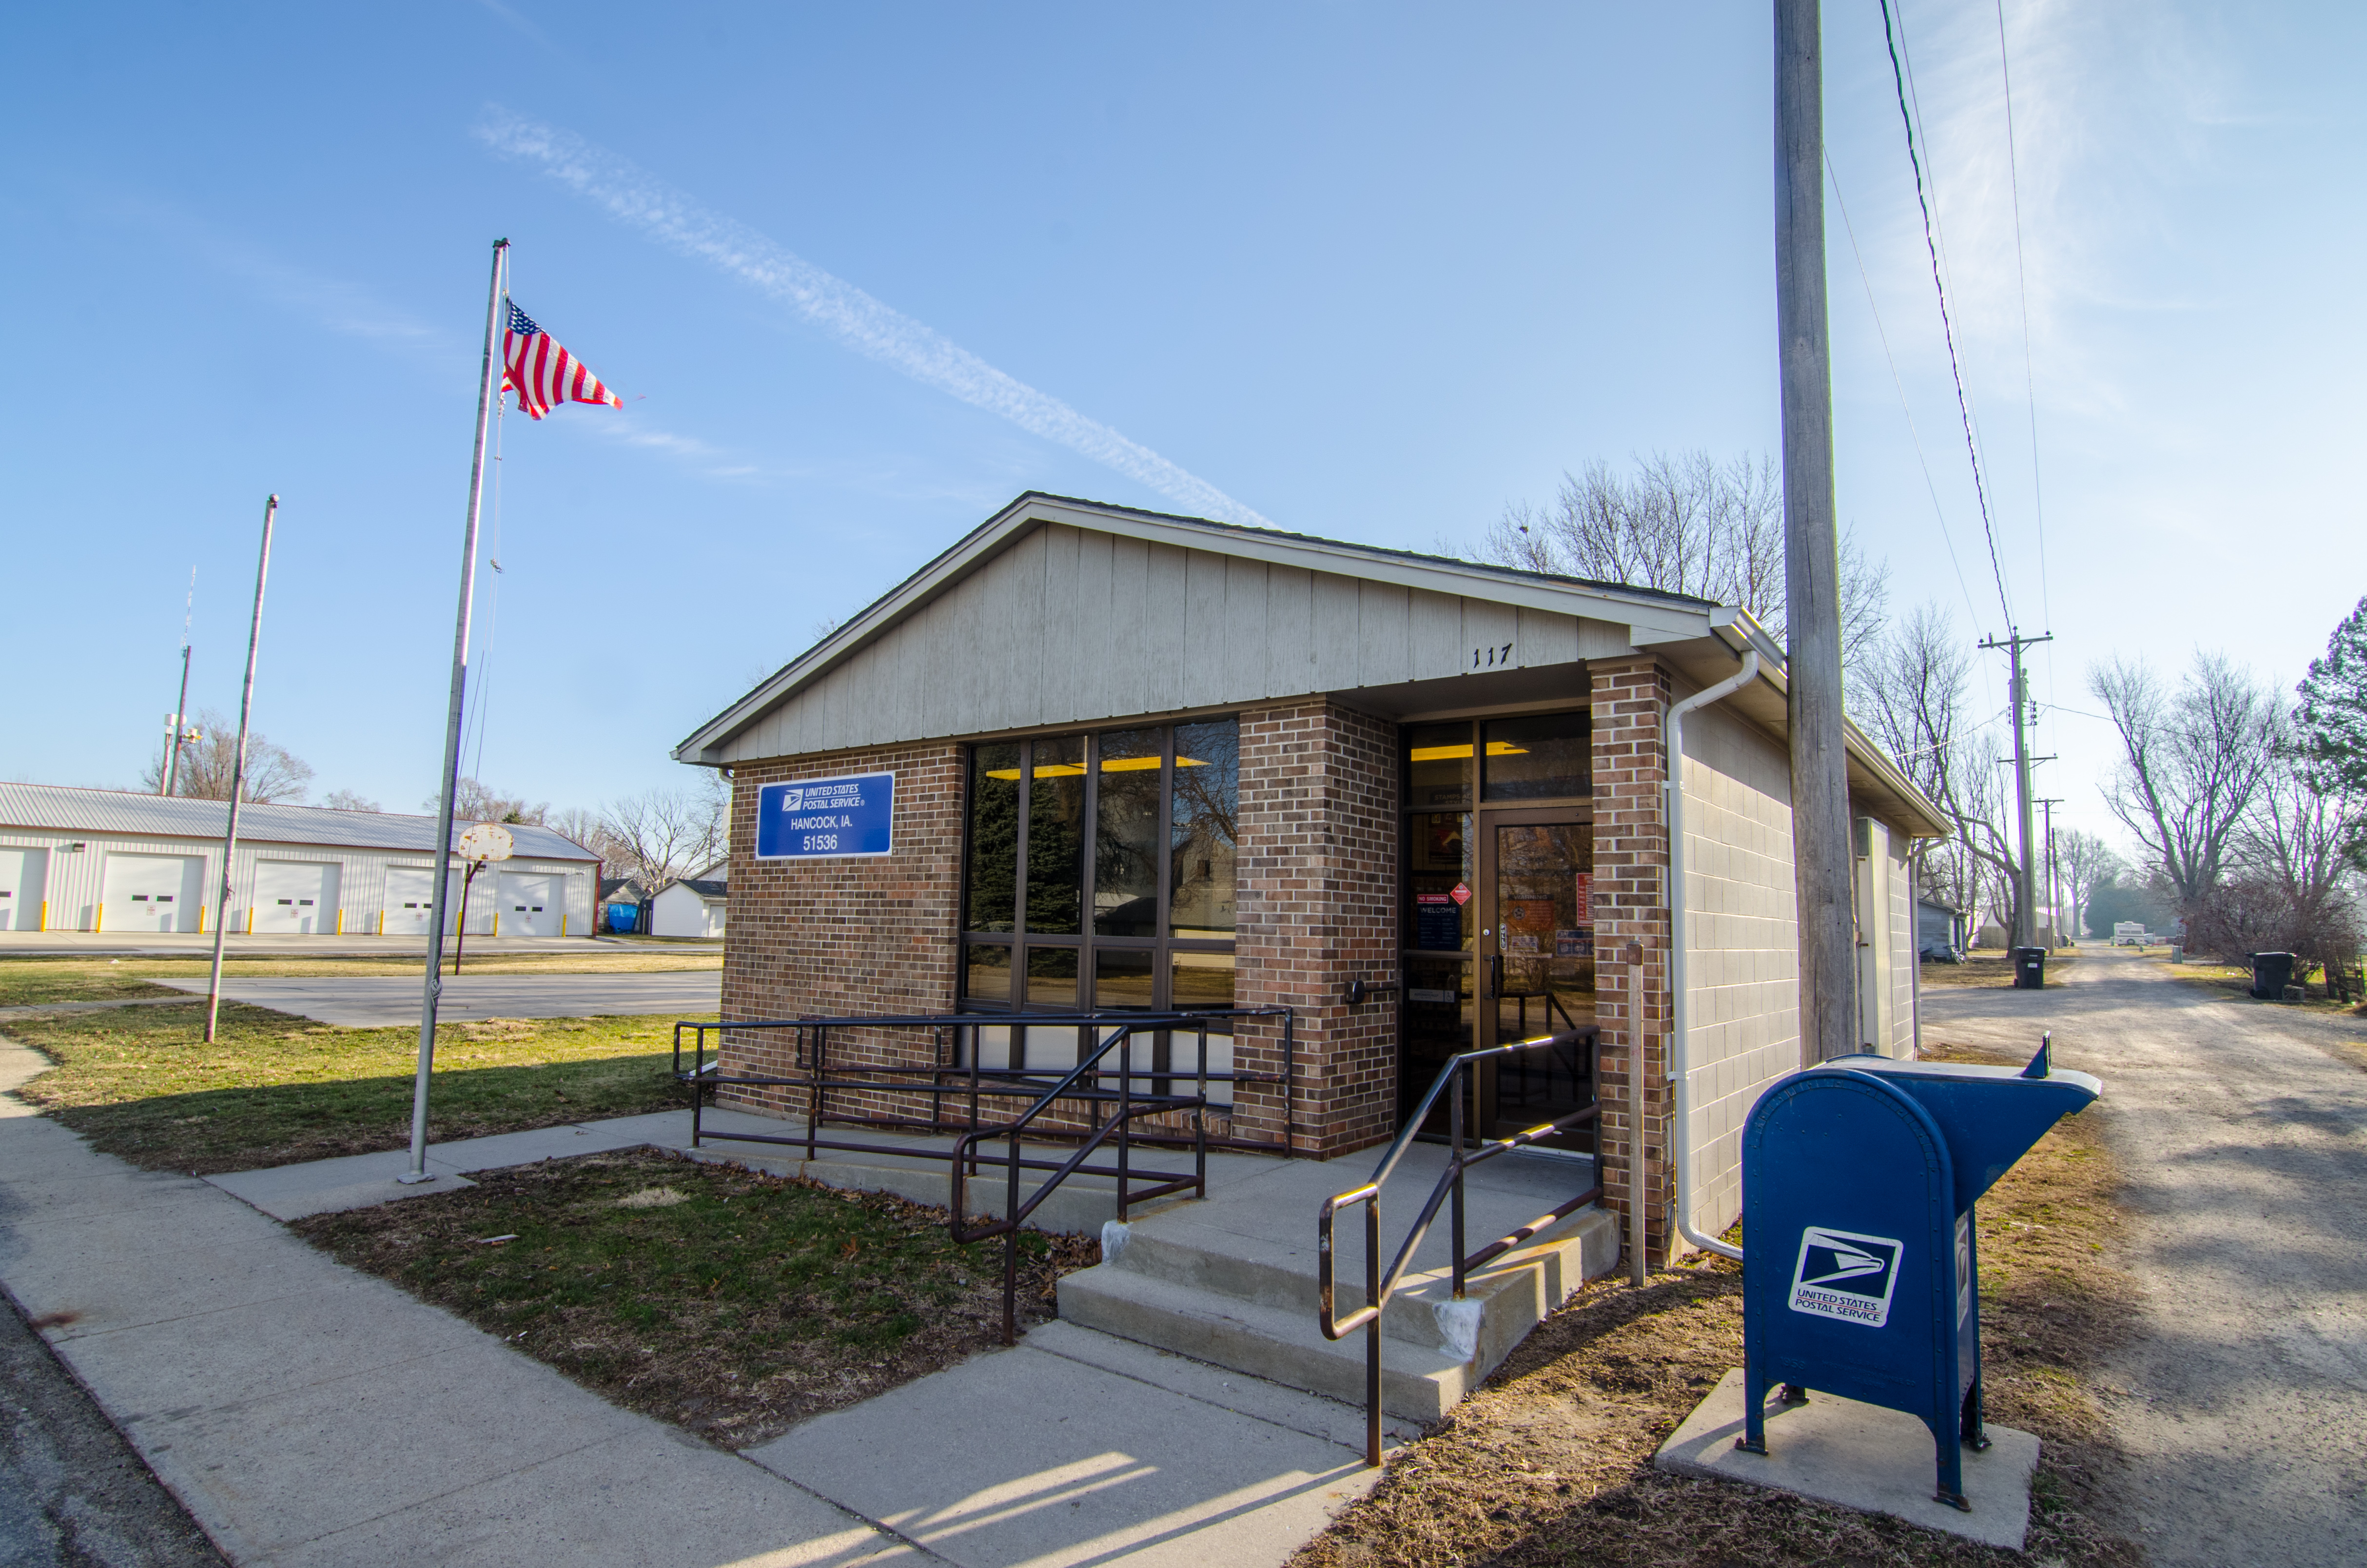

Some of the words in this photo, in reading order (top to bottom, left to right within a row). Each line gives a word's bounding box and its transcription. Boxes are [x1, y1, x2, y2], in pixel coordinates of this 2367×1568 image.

[1473, 643, 1512, 668] 117
[805, 786, 832, 797] UNITED
[832, 783, 859, 795] STATES
[802, 799, 829, 810] POSTAL
[791, 815, 838, 830] HANCOCK,
[841, 815, 853, 827] IA.
[803, 834, 838, 851] 51536
[1797, 1289, 1838, 1303] UNITED
[1839, 1297, 1877, 1311] STATES
[1795, 1298, 1835, 1313] POSTAL
[1836, 1307, 1880, 1322] SERVICE
